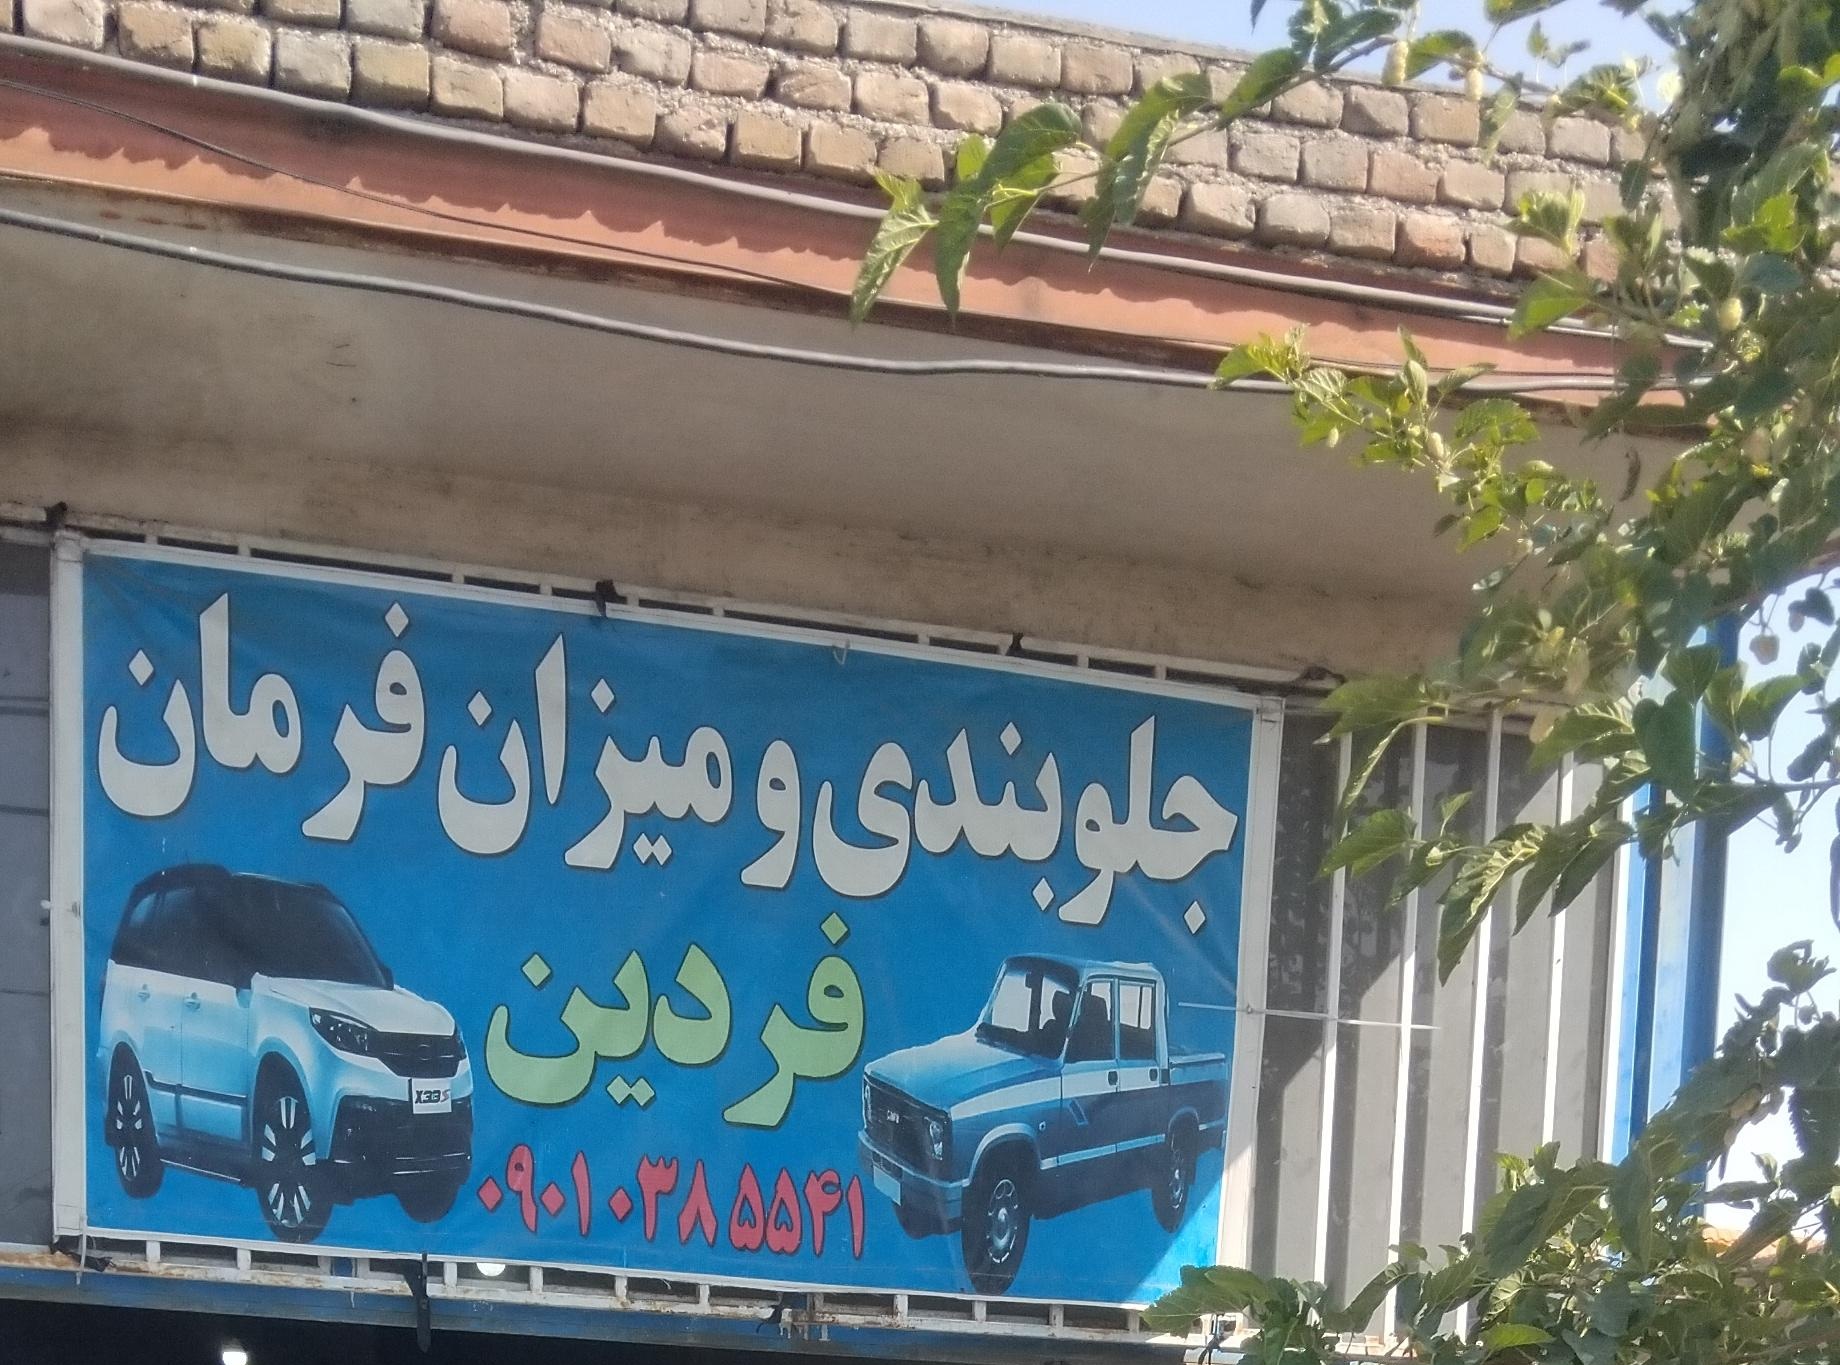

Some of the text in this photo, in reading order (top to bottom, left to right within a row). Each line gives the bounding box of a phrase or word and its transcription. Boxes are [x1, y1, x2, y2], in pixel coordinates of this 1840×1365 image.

[97, 593, 1239, 936] جلوبندی و میزان فرمان
[485, 911, 865, 1129] فردین
